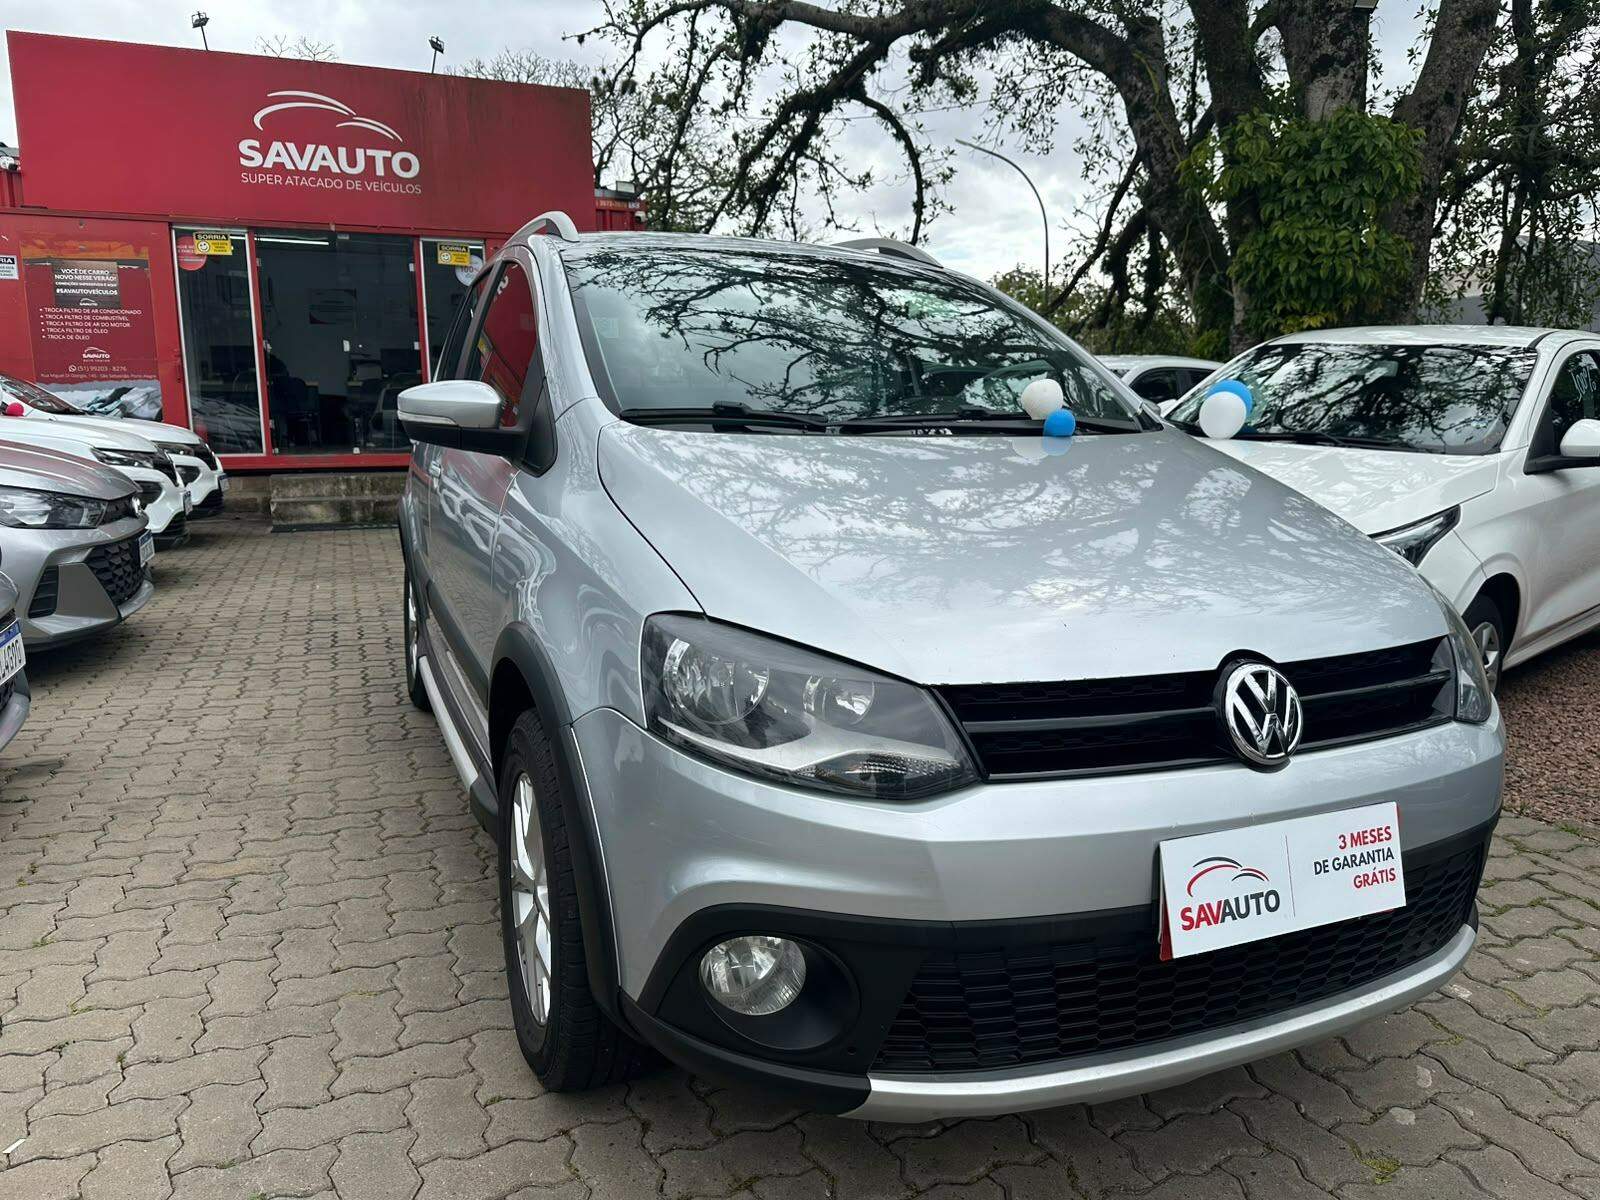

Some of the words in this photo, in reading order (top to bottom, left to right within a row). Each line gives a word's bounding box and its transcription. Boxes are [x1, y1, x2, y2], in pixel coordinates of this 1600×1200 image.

[238, 138, 420, 179] SAVAUTO
[241, 172, 282, 185] SUPER
[285, 175, 343, 190] ATACADO
[346, 179, 363, 191] DE
[364, 179, 422, 194] VEÍCULOS
[1337, 833, 1348, 850] 3
[1350, 825, 1393, 848] MESES
[1313, 858, 1330, 876] DE
[1331, 846, 1395, 872] GARANTIA
[1353, 866, 1397, 889] GRÁTIS
[1179, 888, 1281, 932] SAVAUTO
